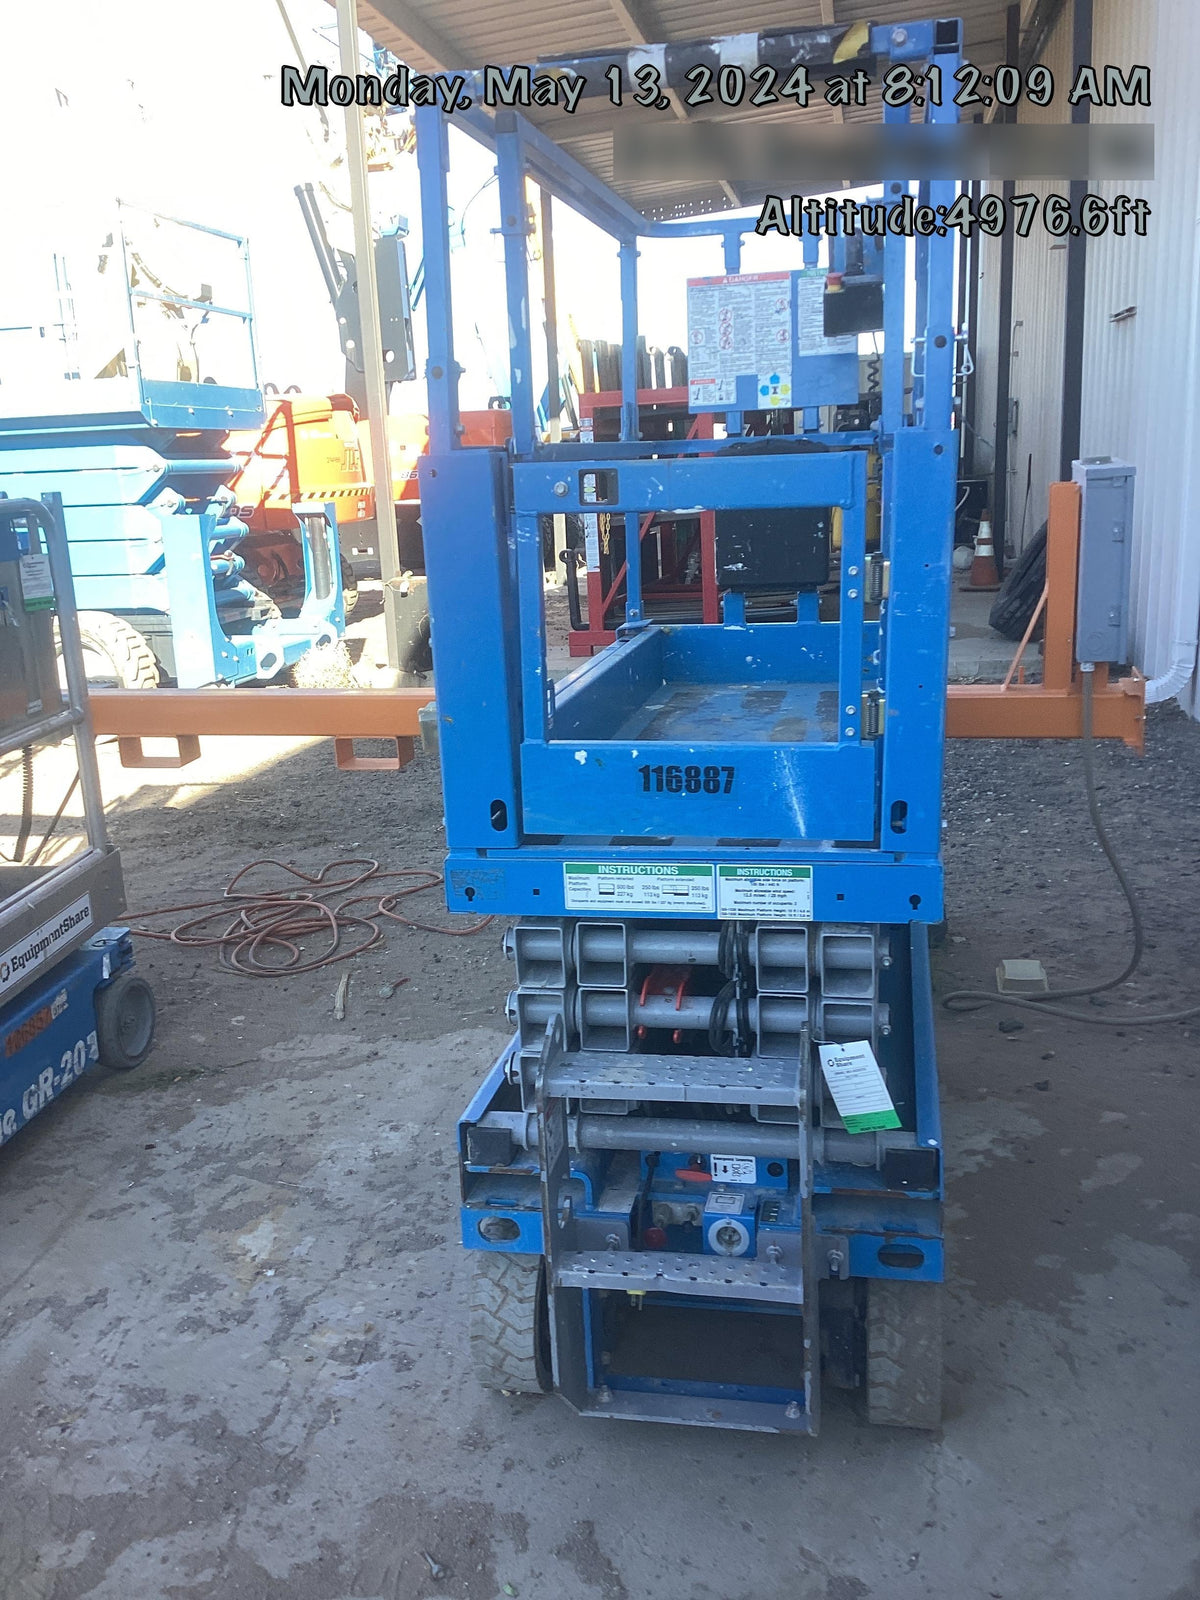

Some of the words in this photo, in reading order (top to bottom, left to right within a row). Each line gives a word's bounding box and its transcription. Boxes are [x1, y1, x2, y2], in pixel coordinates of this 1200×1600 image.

[638, 764, 735, 794] 116887
[598, 865, 679, 875] INSTRUCTIONS
[736, 868, 793, 876] INSTRUCTIONS
[10, 906, 90, 972] EquipmentShare
